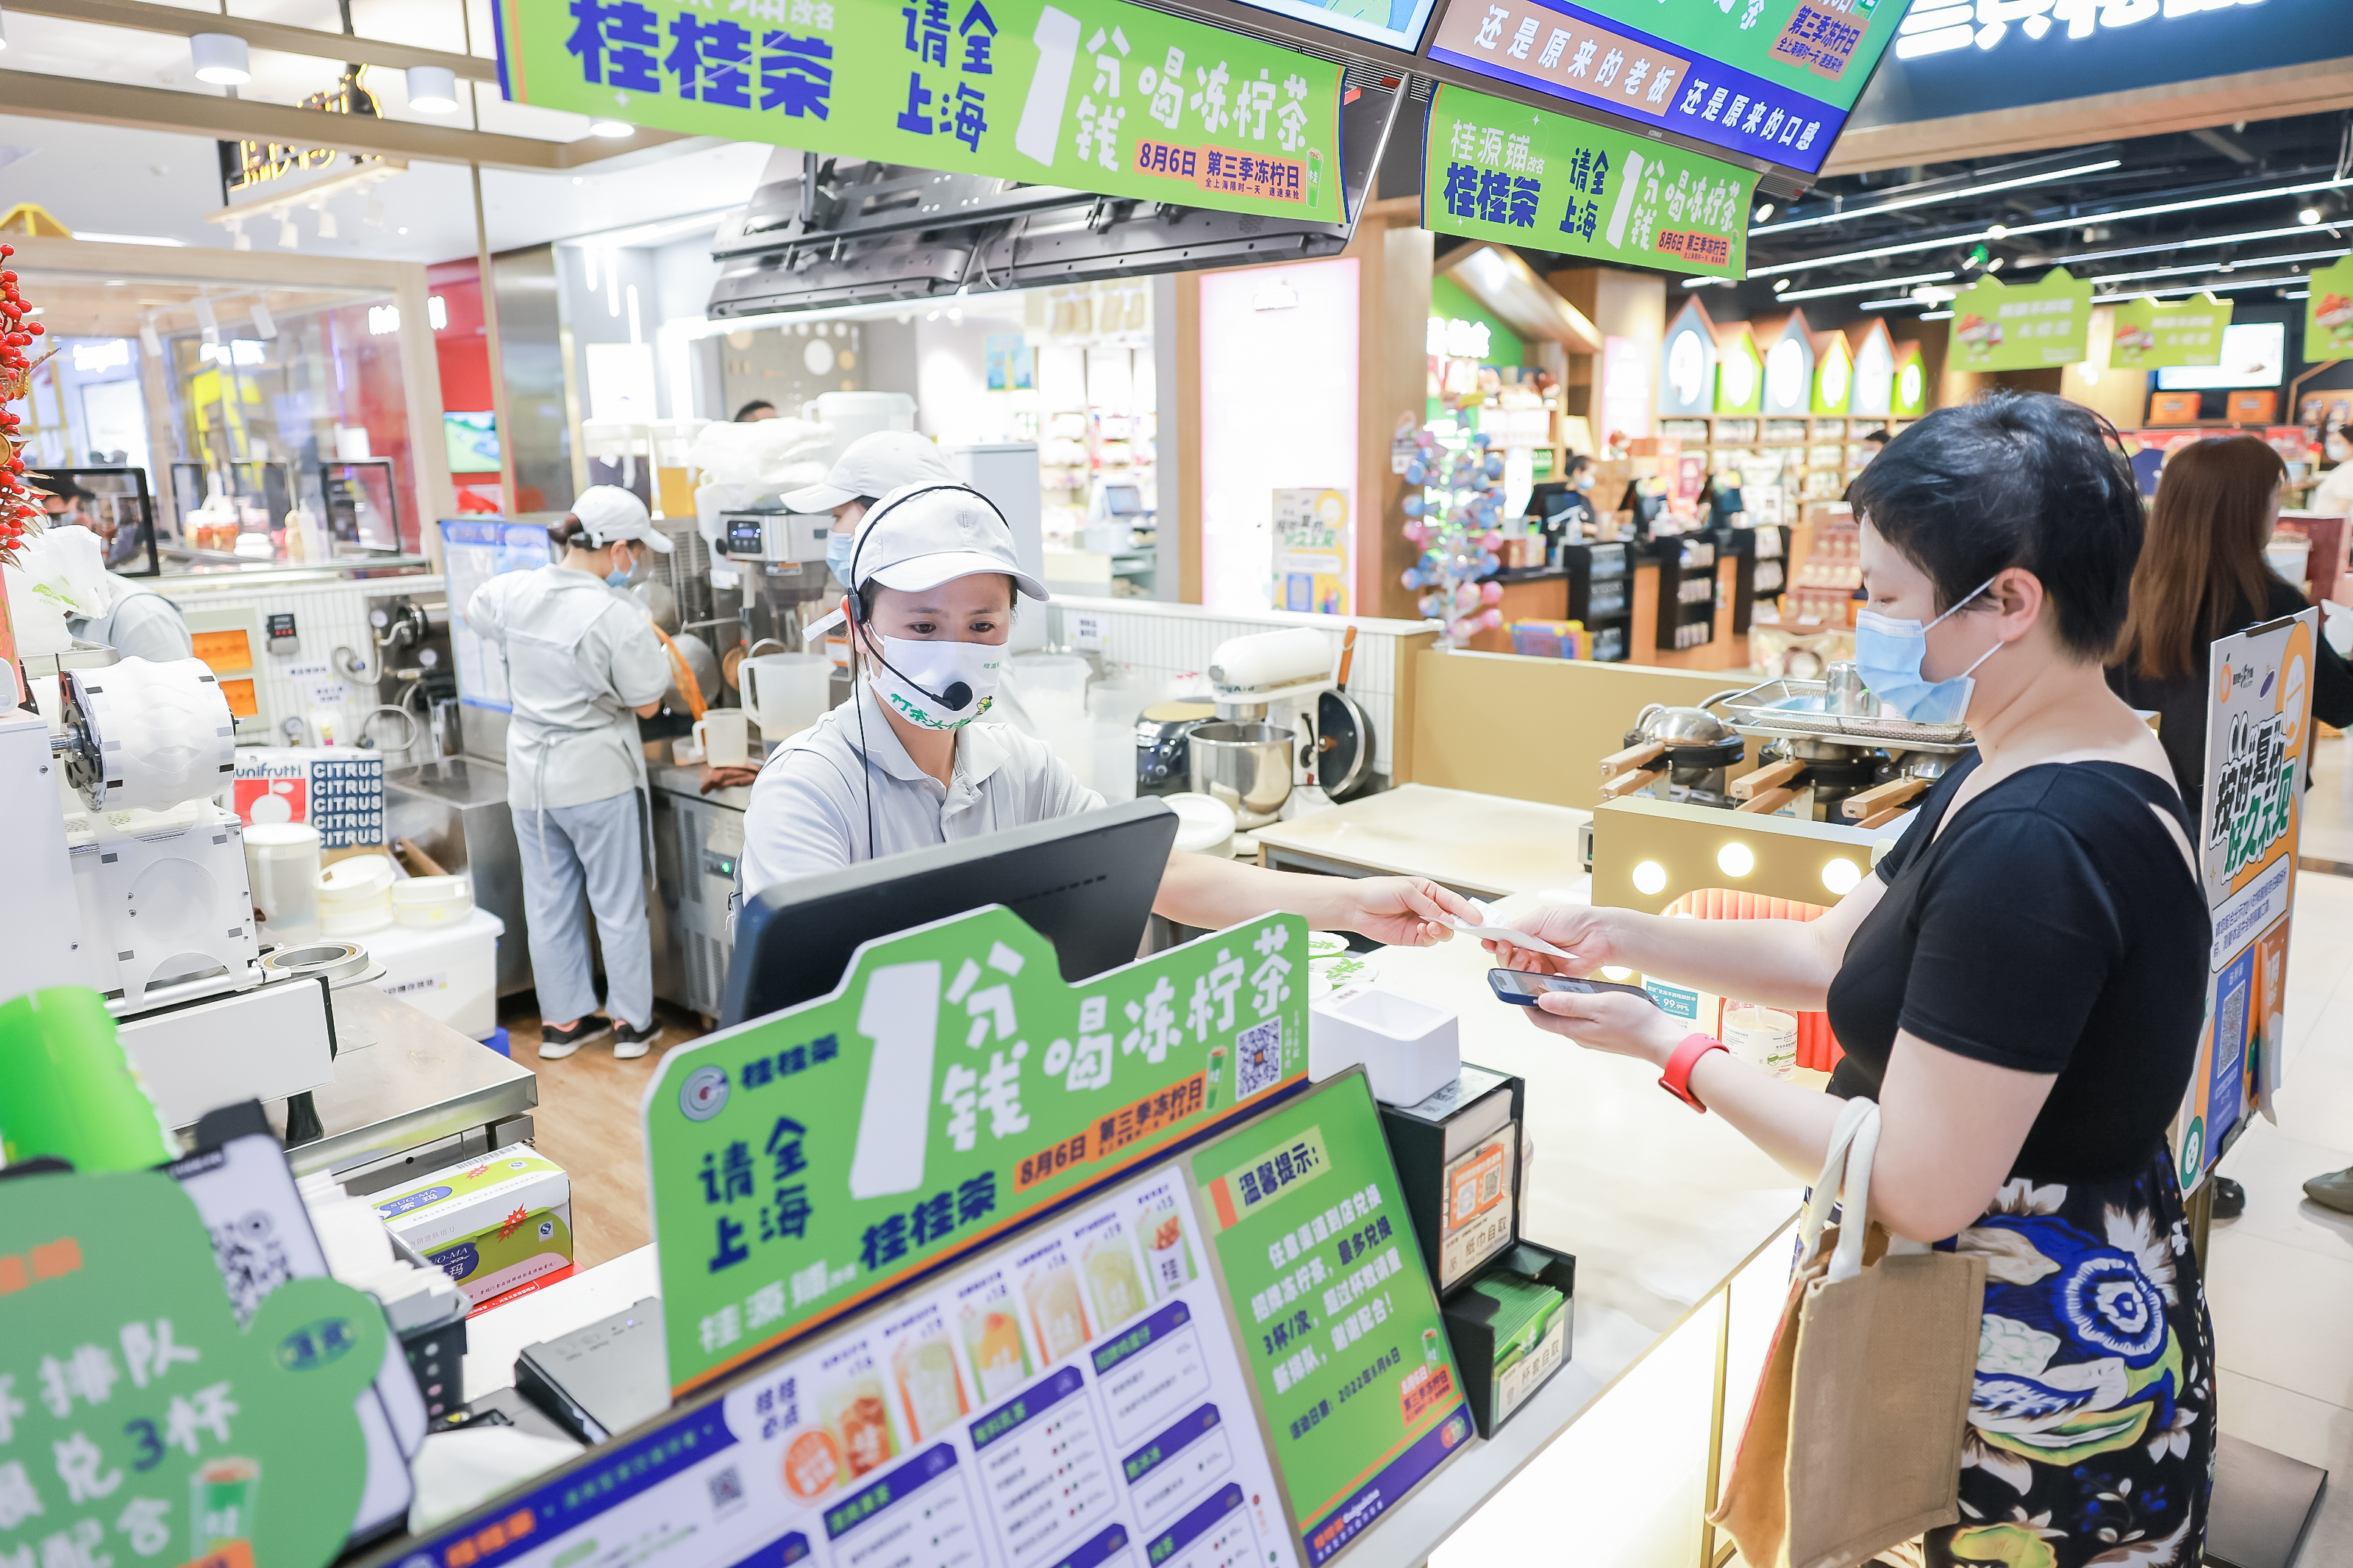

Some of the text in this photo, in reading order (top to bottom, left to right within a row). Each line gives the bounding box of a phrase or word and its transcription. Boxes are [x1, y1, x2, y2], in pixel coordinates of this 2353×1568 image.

[565, 0, 833, 121] 桂桂茶
[1015, 4, 1082, 168] 1
[1085, 24, 1132, 99] 分
[1473, 3, 1677, 106] 还是原来的老板
[896, 71, 988, 154] 上海
[1138, 46, 1308, 154] 喝冻柠茶
[1679, 77, 1821, 151] 还是原来的口感
[1075, 95, 1126, 173] 钱
[1139, 143, 1300, 190] 8月6日 第三季冻柠日
[1450, 119, 1546, 176] 桂源铺 改名
[1205, 177, 1261, 196] 全上海限时一天
[1443, 161, 1542, 229] 桂桂茶
[1606, 149, 1646, 251] 1
[1644, 159, 1665, 205] 分
[1665, 169, 1742, 233] 喝冻柠茶
[1559, 195, 1599, 244] 上海
[1630, 203, 1658, 252] 钱
[1658, 230, 1685, 254] 8月6日
[235, 762, 301, 778] unifrutti
[313, 762, 382, 778] CITRUS
[313, 778, 382, 796] CITRUS
[313, 795, 382, 813] CITRUS
[313, 812, 382, 830] CITRUS
[2224, 767, 2295, 875] 好久不见
[945, 939, 1026, 1049] 分
[1043, 923, 1293, 1092] 喝冻柠茶
[1663, 998, 1690, 1012] 99.99%
[848, 959, 942, 1200] 1
[942, 1039, 1031, 1153] 钱
[1099, 1077, 1203, 1144] 第三季冻柠日
[1019, 1133, 1087, 1186] 8月6日
[390, 1189, 438, 1209] SUO-MA
[707, 1184, 814, 1275] 上海
[860, 1170, 997, 1272] 桂桂茶
[1268, 1182, 1383, 1271] 任意渠道到店兑换
[429, 1247, 468, 1265] UO-MA
